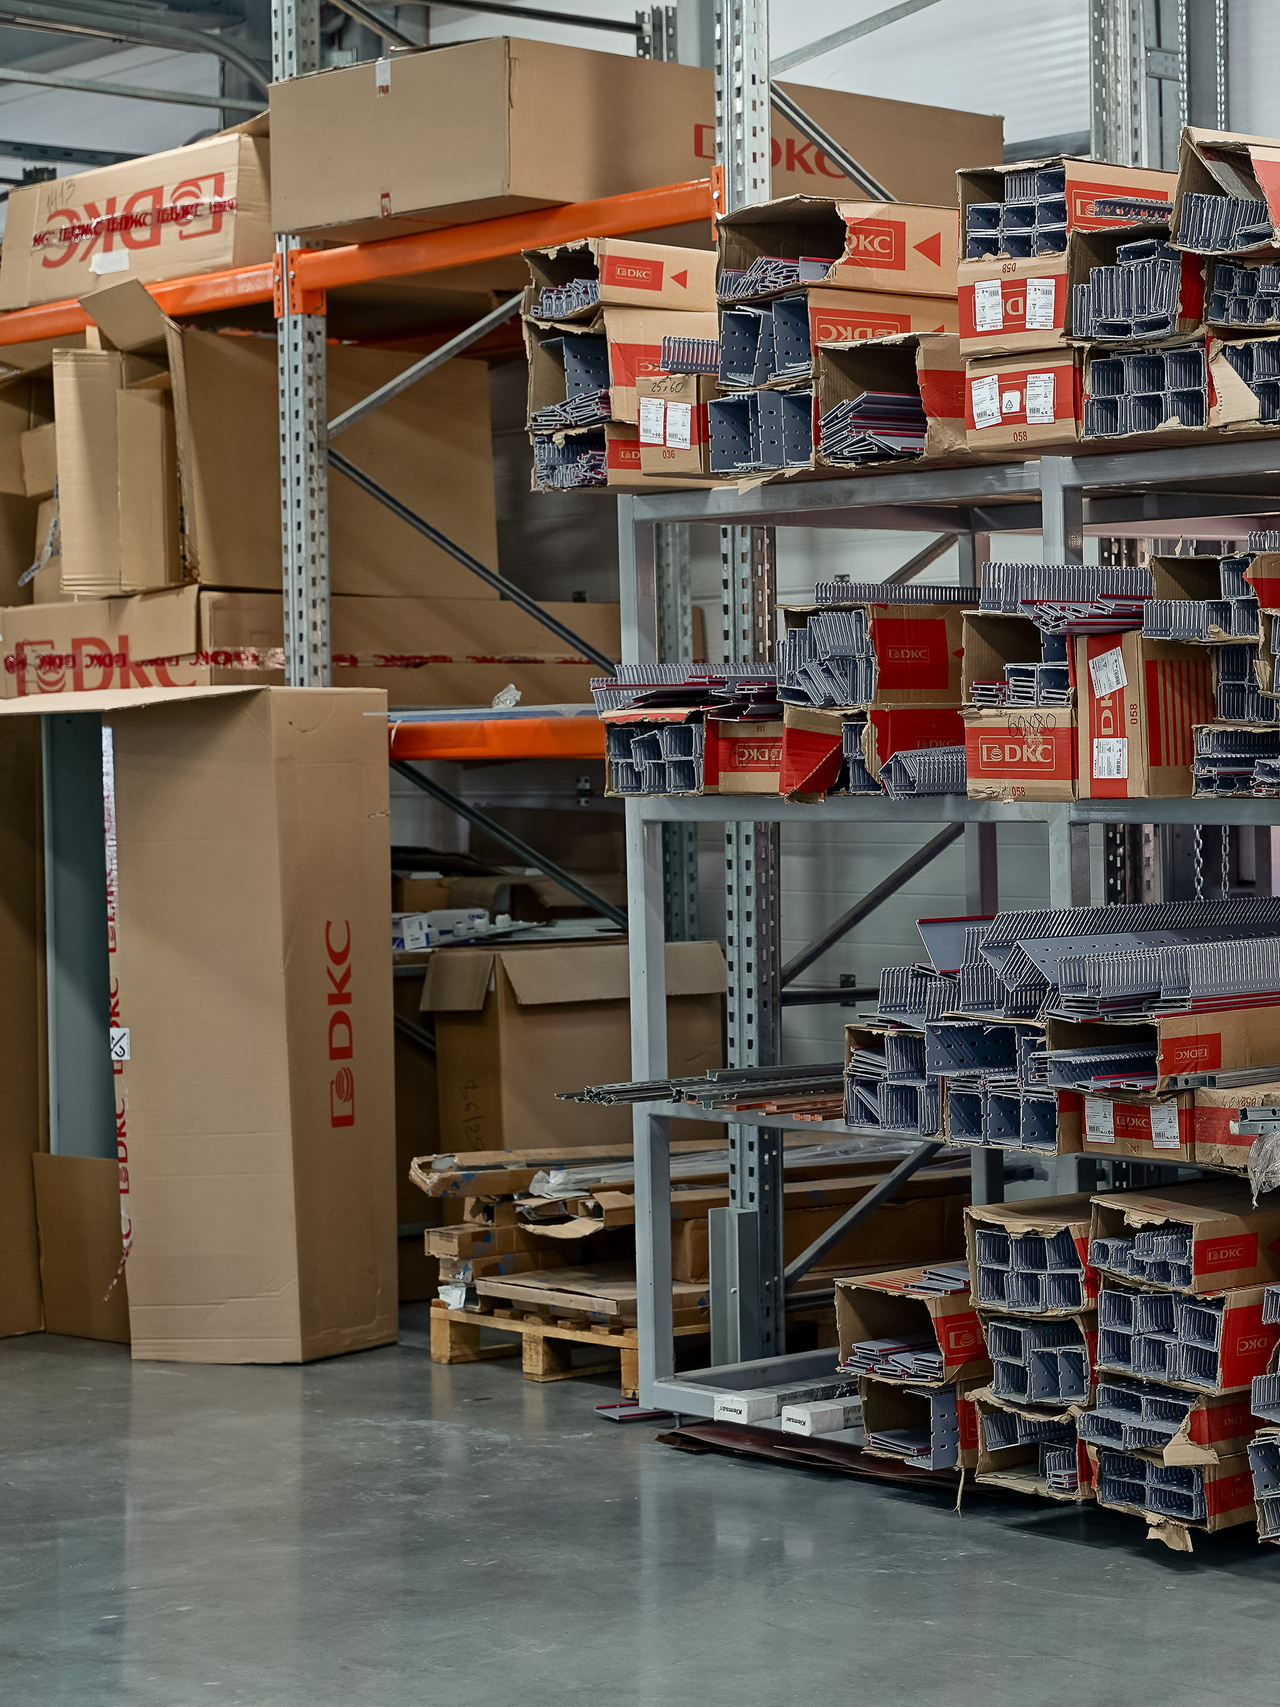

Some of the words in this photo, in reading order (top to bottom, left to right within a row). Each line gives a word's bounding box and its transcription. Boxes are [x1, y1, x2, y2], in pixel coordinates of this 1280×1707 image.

[41, 185, 164, 269] DKC
[627, 268, 651, 279] DKC
[1002, 262, 1017, 273] 058
[819, 324, 873, 341] DKC
[1013, 431, 1028, 442] 058
[662, 450, 676, 459] 036
[900, 648, 928, 659] DKC
[1100, 693, 1114, 736] DK
[1129, 703, 1138, 725] 058
[929, 739, 956, 749] DKC
[738, 748, 771, 761] DKC
[1004, 744, 1052, 763] DKC
[1011, 786, 1026, 797] 058
[326, 919, 353, 1061] DKC
[1175, 1049, 1198, 1060] DKC
[1126, 1116, 1149, 1128] DKC
[1219, 1247, 1244, 1259] DKC
[1240, 1337, 1268, 1352] DKC
[719, 1406, 742, 1415] Klemsan
[785, 1416, 806, 1426] Klemsan
[1219, 1415, 1243, 1428] DKC
